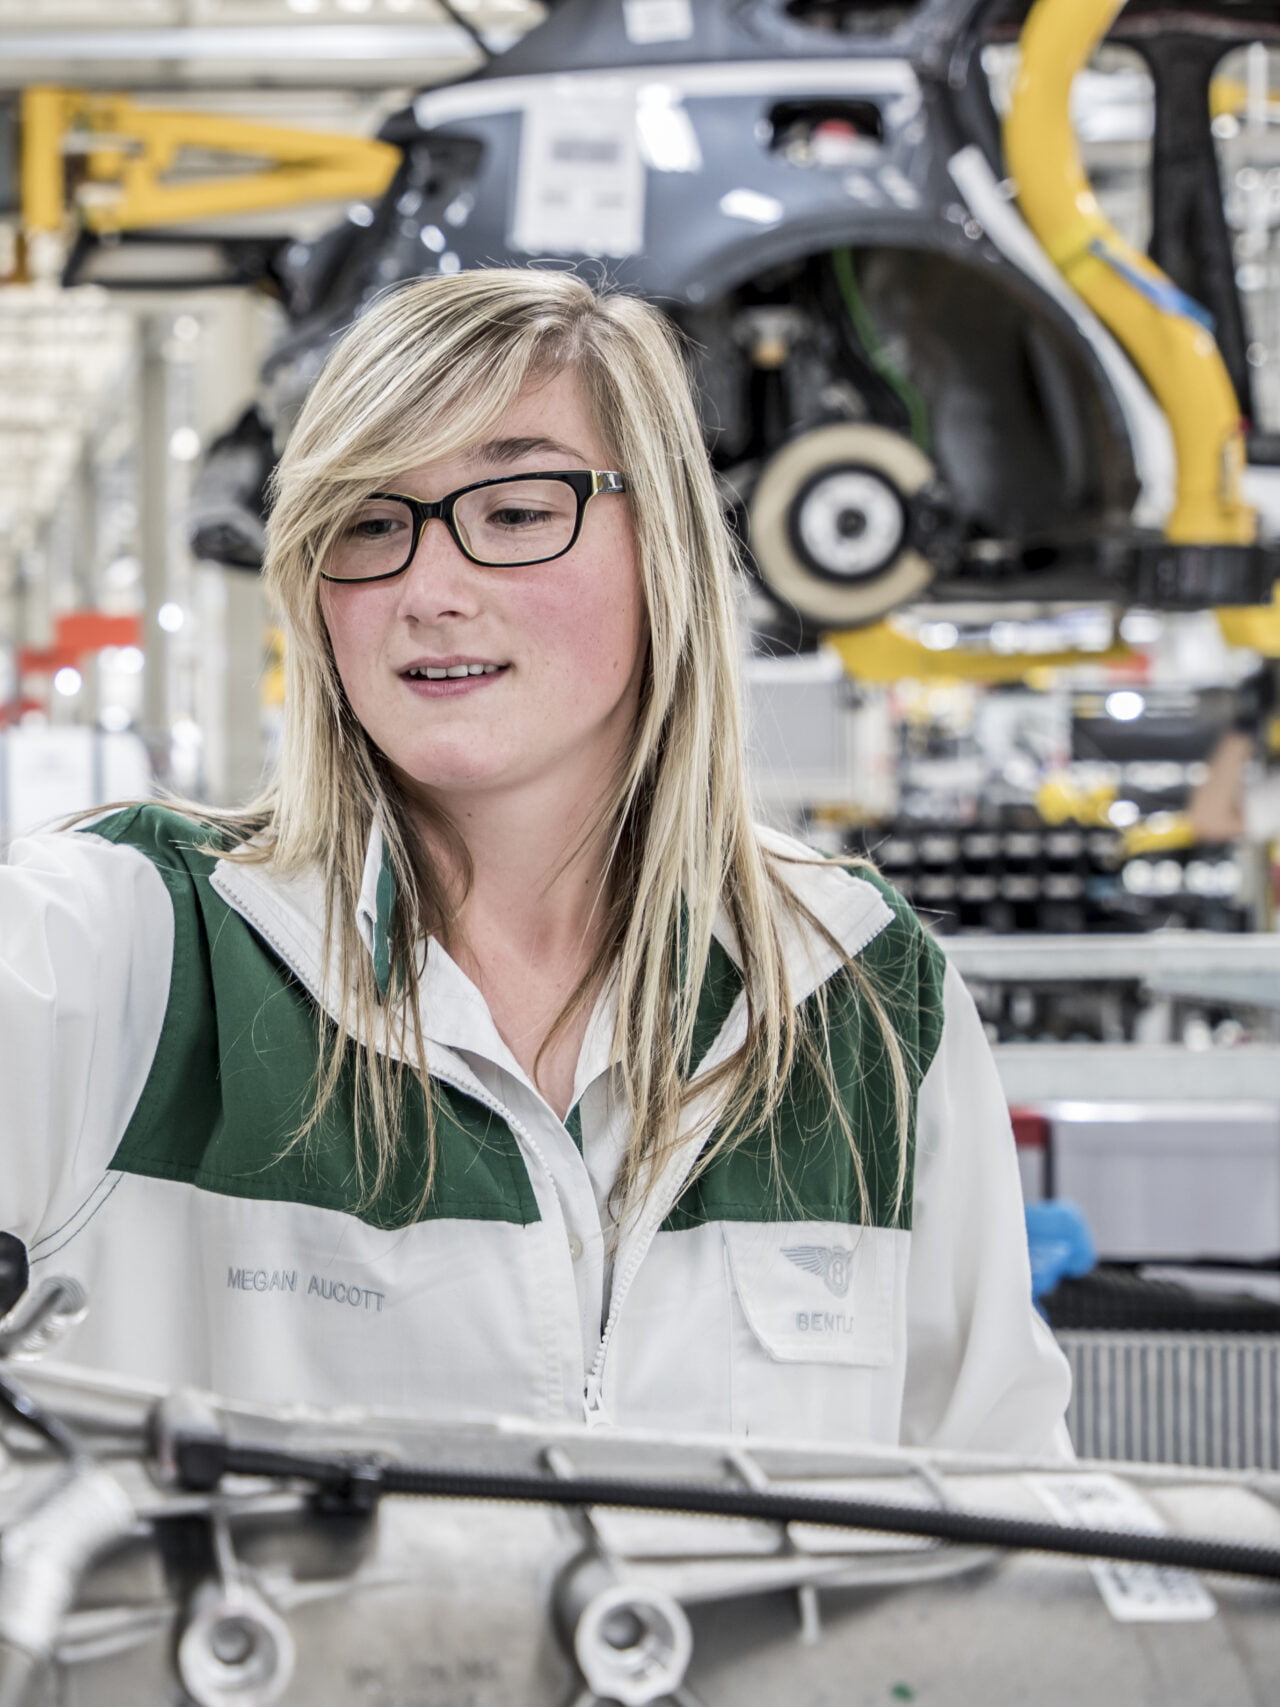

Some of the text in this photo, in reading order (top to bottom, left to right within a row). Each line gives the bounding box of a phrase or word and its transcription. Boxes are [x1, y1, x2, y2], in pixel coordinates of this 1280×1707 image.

[227, 1266, 385, 1312] MEGAN AUCOTT
[795, 1311, 855, 1334] BENTL
